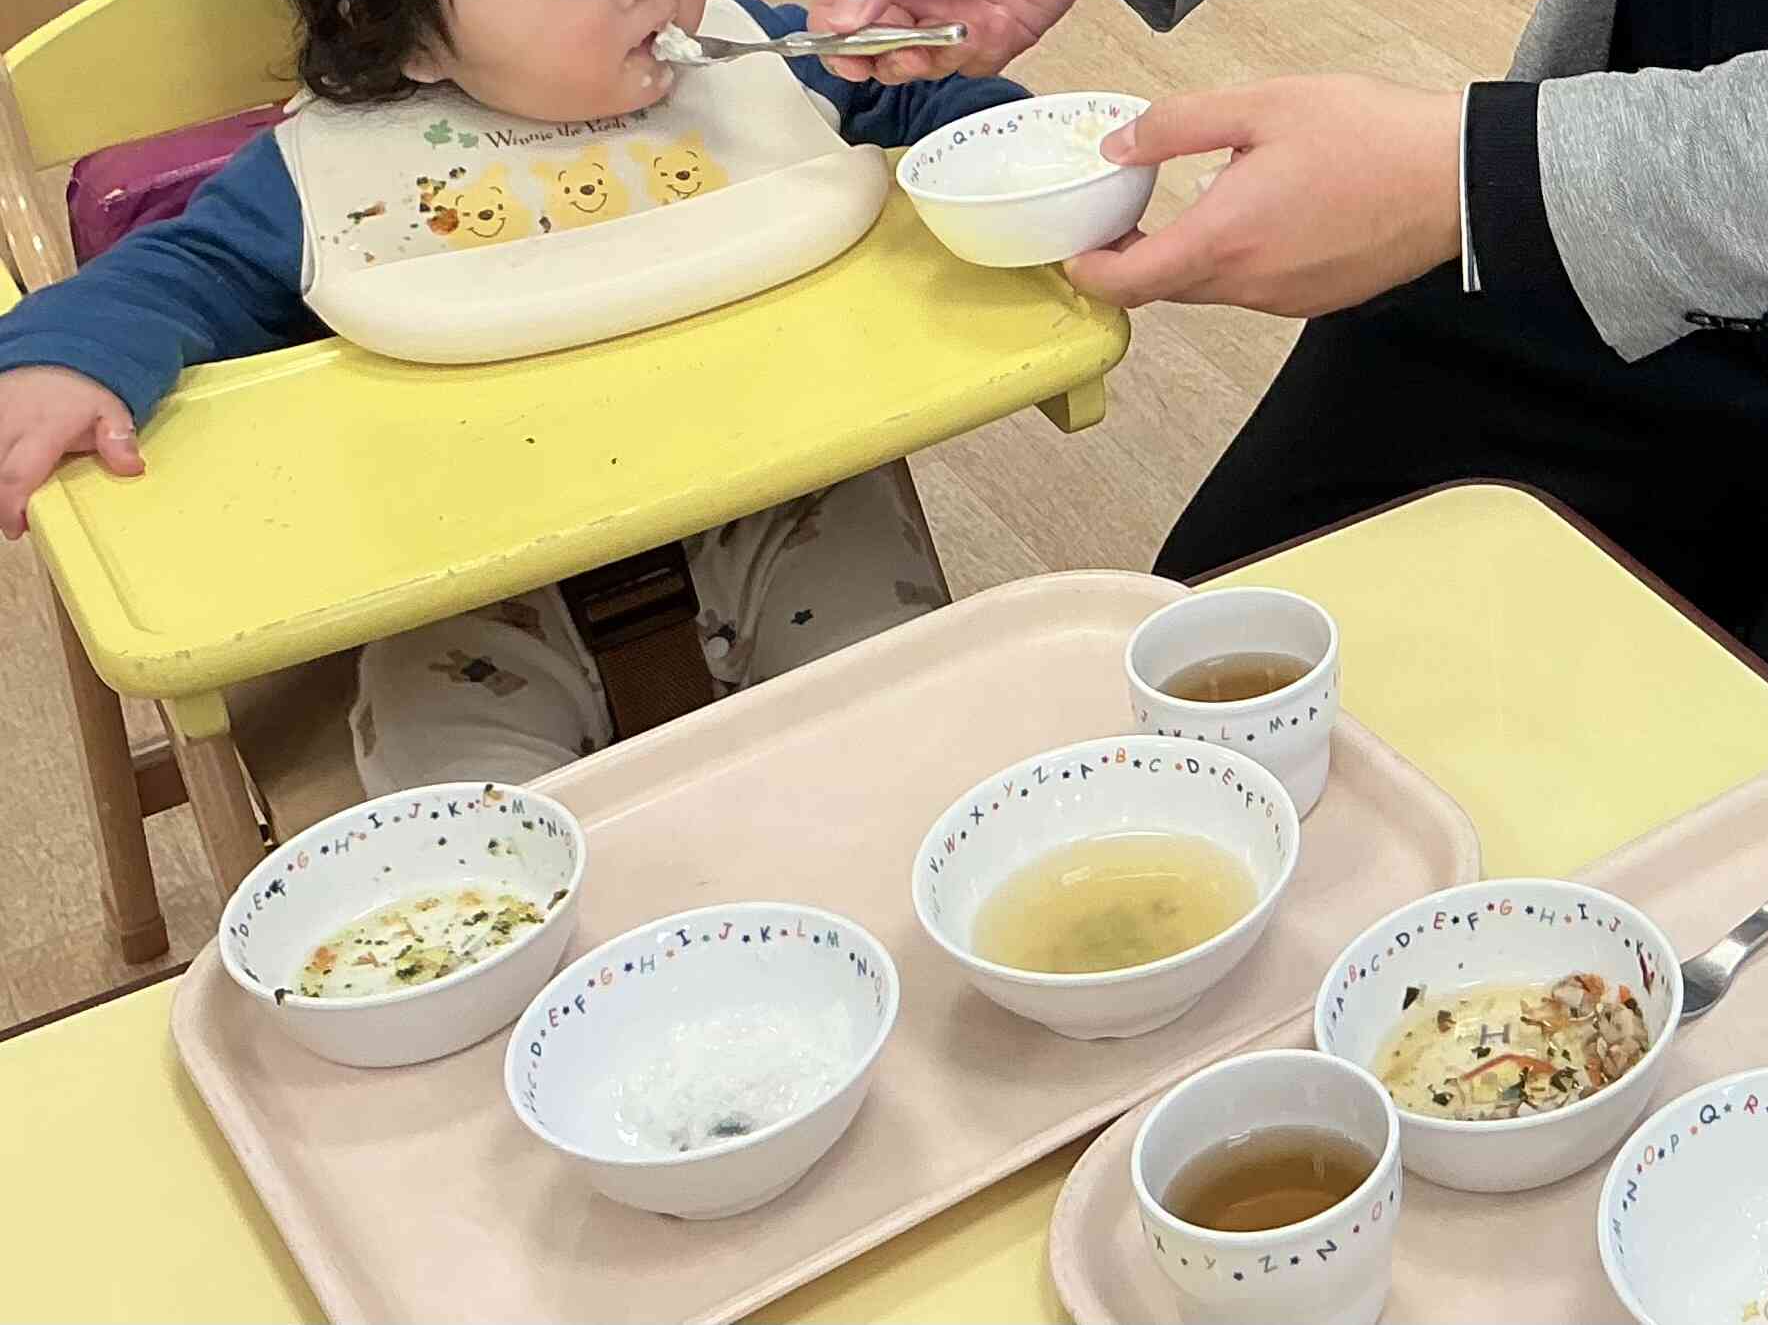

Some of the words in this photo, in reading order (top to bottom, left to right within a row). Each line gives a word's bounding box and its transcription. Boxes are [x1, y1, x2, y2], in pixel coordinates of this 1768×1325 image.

[485, 129, 554, 149] Winnie
[556, 121, 583, 138] the
[953, 131, 968, 146] Q
[981, 123, 992, 136] R
[1007, 120, 1018, 132] S
[1033, 110, 1043, 121] T
[1087, 100, 1097, 112] V
[1109, 104, 1121, 118] W
[1221, 726, 1231, 740] L
[1269, 716, 1285, 734] M
[944, 834, 956, 854] W
[969, 805, 984, 826] X
[1003, 780, 1013, 797] Y
[1032, 765, 1049, 784] Z
[1080, 763, 1093, 779] A
[1115, 747, 1126, 763] B
[1149, 758, 1161, 772] C
[1187, 758, 1199, 774] D
[1222, 768, 1235, 785] E
[1246, 791, 1254, 808] F
[239, 923, 249, 937] D
[252, 892, 263, 911] E
[335, 837, 350, 854] H
[368, 812, 383, 829] I
[409, 802, 421, 819] J
[448, 801, 462, 818] K
[512, 799, 525, 814] M
[547, 820, 558, 838] N
[1349, 963, 1358, 983] B
[1371, 954, 1380, 972] C
[1396, 932, 1410, 948] D
[1433, 911, 1447, 930] E
[1467, 912, 1479, 931] F
[1500, 899, 1512, 916] G
[1539, 908, 1556, 925] H
[1577, 903, 1589, 920] I
[1608, 917, 1621, 933] J
[530, 1042, 542, 1057] D
[548, 1007, 559, 1028] E
[574, 994, 586, 1014] F
[600, 967, 613, 985] G
[640, 953, 655, 974] H
[676, 929, 692, 947] I
[719, 922, 733, 940] J
[760, 925, 771, 942] K
[797, 920, 806, 937] L
[827, 932, 840, 948] M
[857, 959, 867, 976] N
[1644, 1145, 1655, 1165] O
[1670, 1134, 1679, 1153] P
[1700, 1104, 1721, 1124] Q
[1744, 1094, 1759, 1115] R
[1153, 1233, 1166, 1254] X
[1204, 1254, 1216, 1270] Y
[1258, 1255, 1278, 1274] Z
[1372, 1201, 1383, 1222] O
